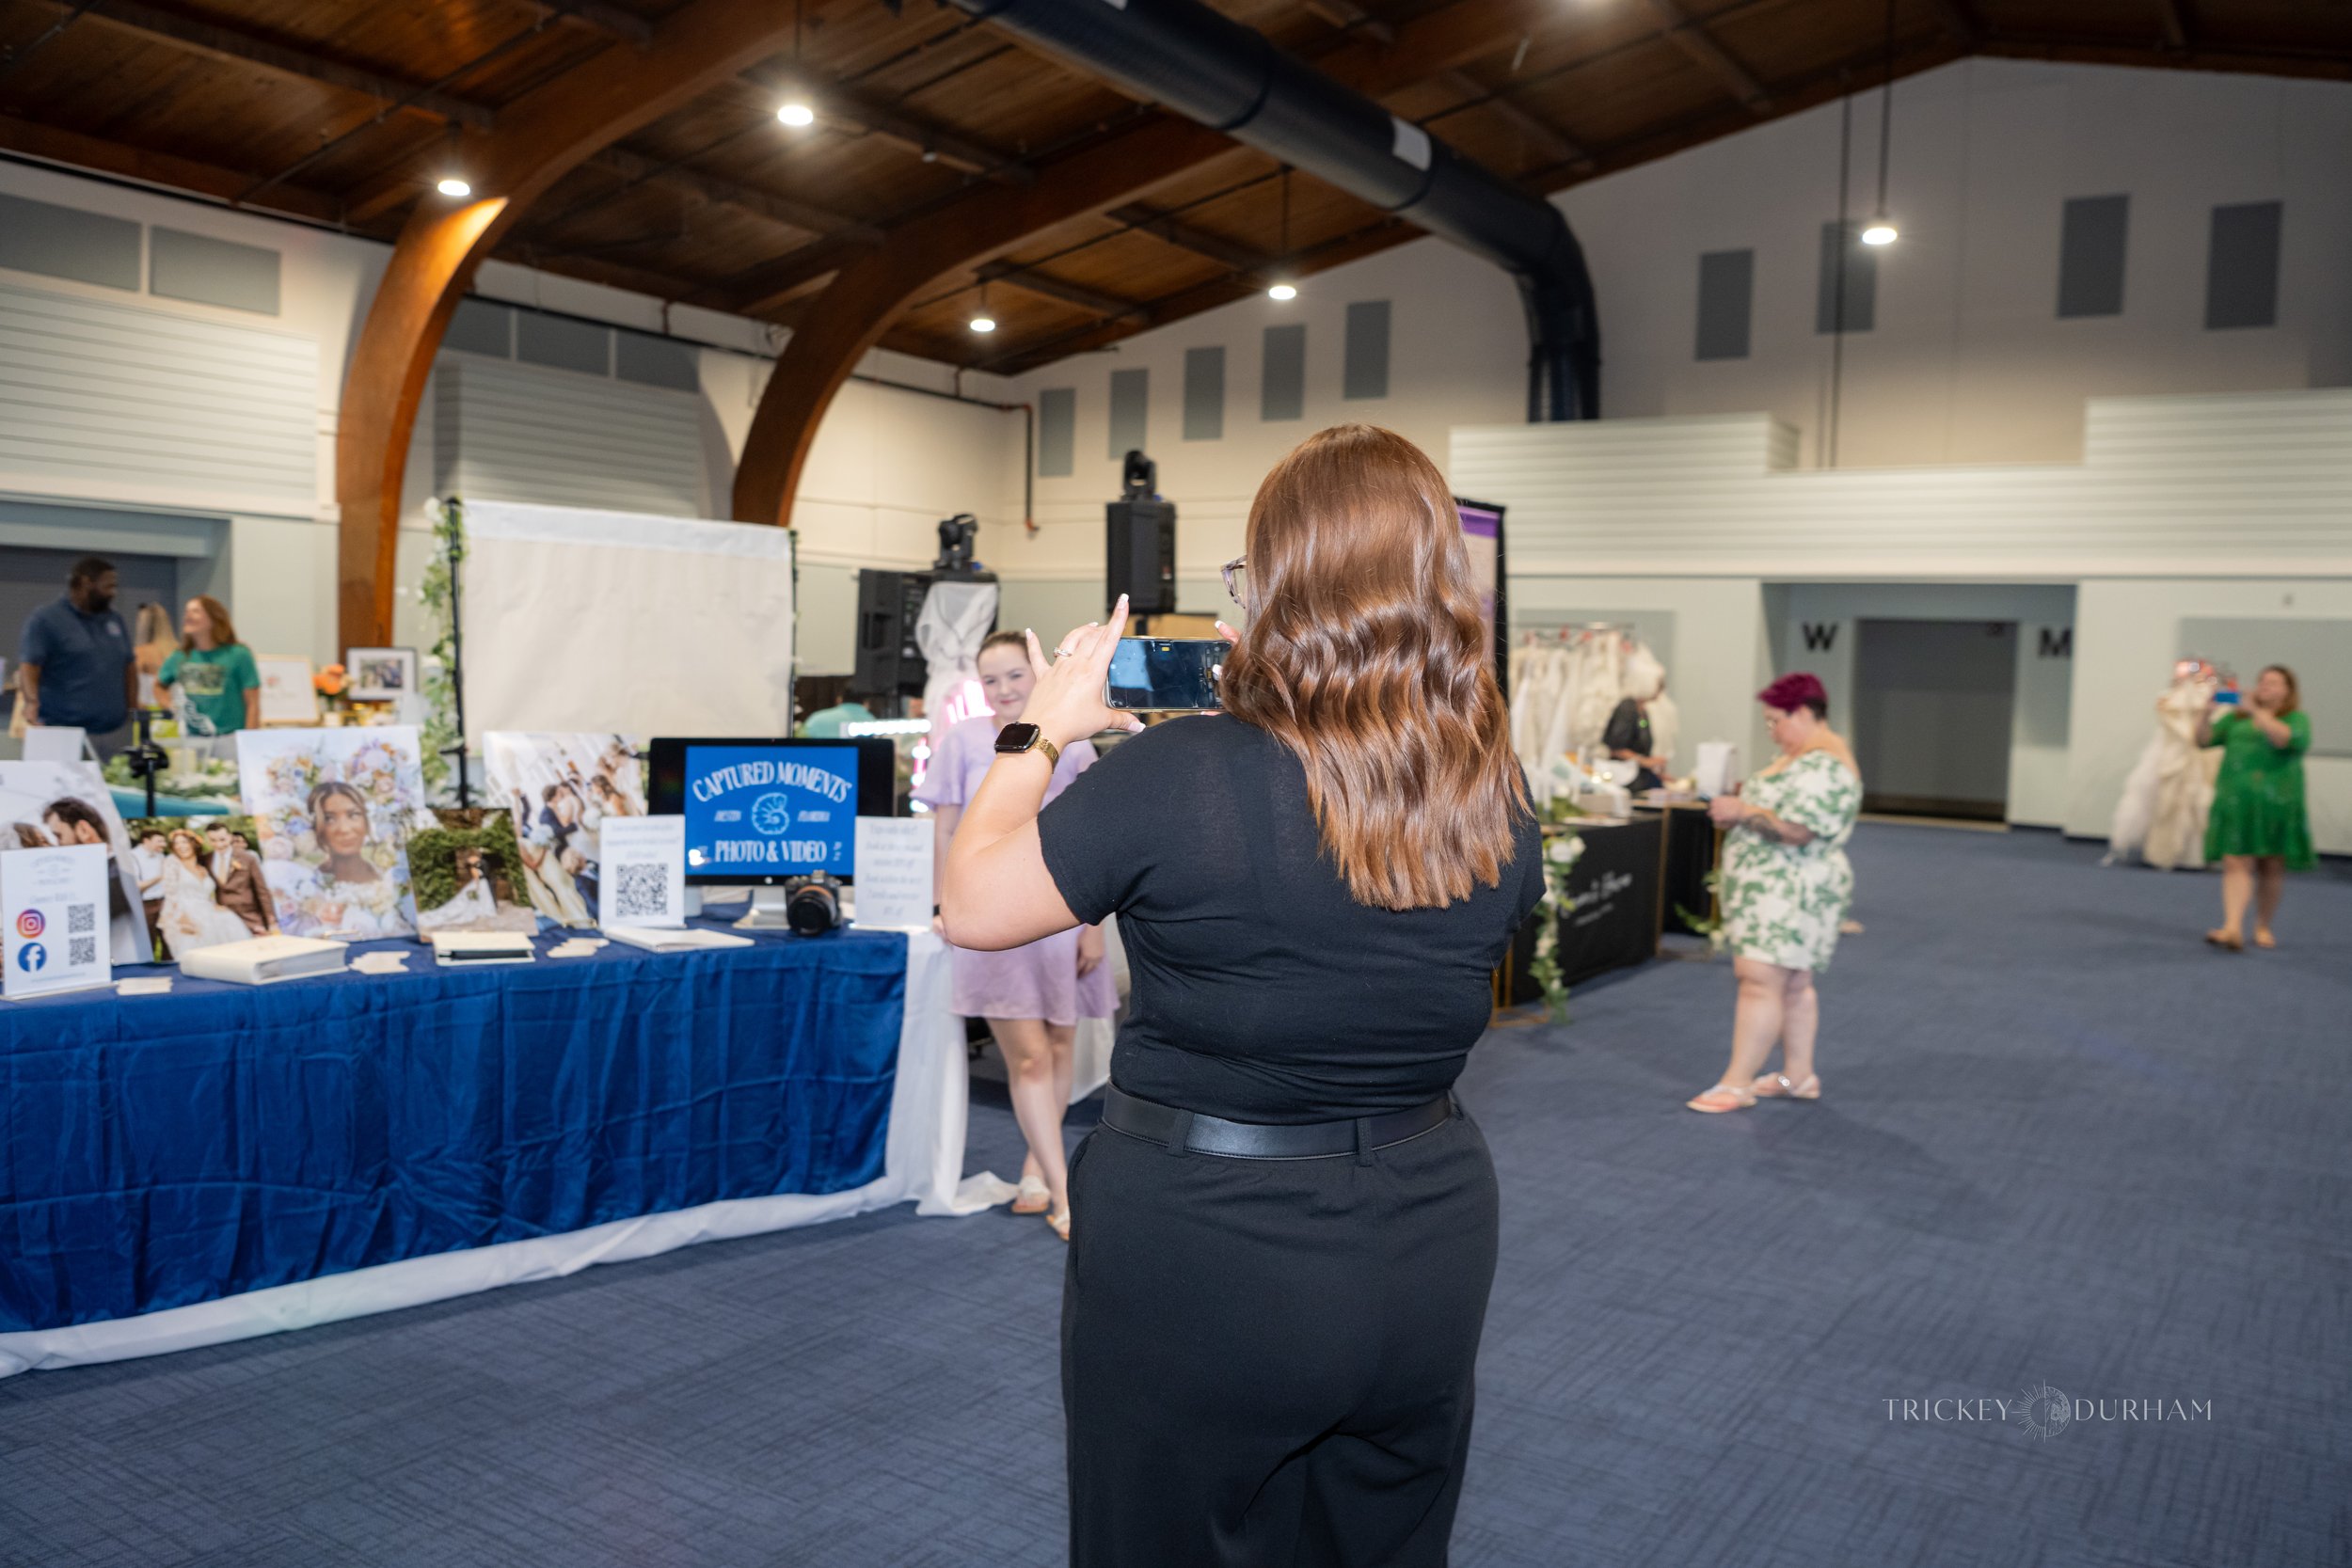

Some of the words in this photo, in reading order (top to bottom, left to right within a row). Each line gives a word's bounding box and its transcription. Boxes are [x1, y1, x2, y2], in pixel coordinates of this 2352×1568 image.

[1802, 622, 1838, 653] W
[2038, 626, 2072, 658] M
[691, 760, 775, 802] CAPTURED
[776, 761, 852, 803] MOMENTS
[714, 840, 765, 863] PHOTO
[765, 840, 780, 863] &
[781, 840, 828, 863] VIDEO
